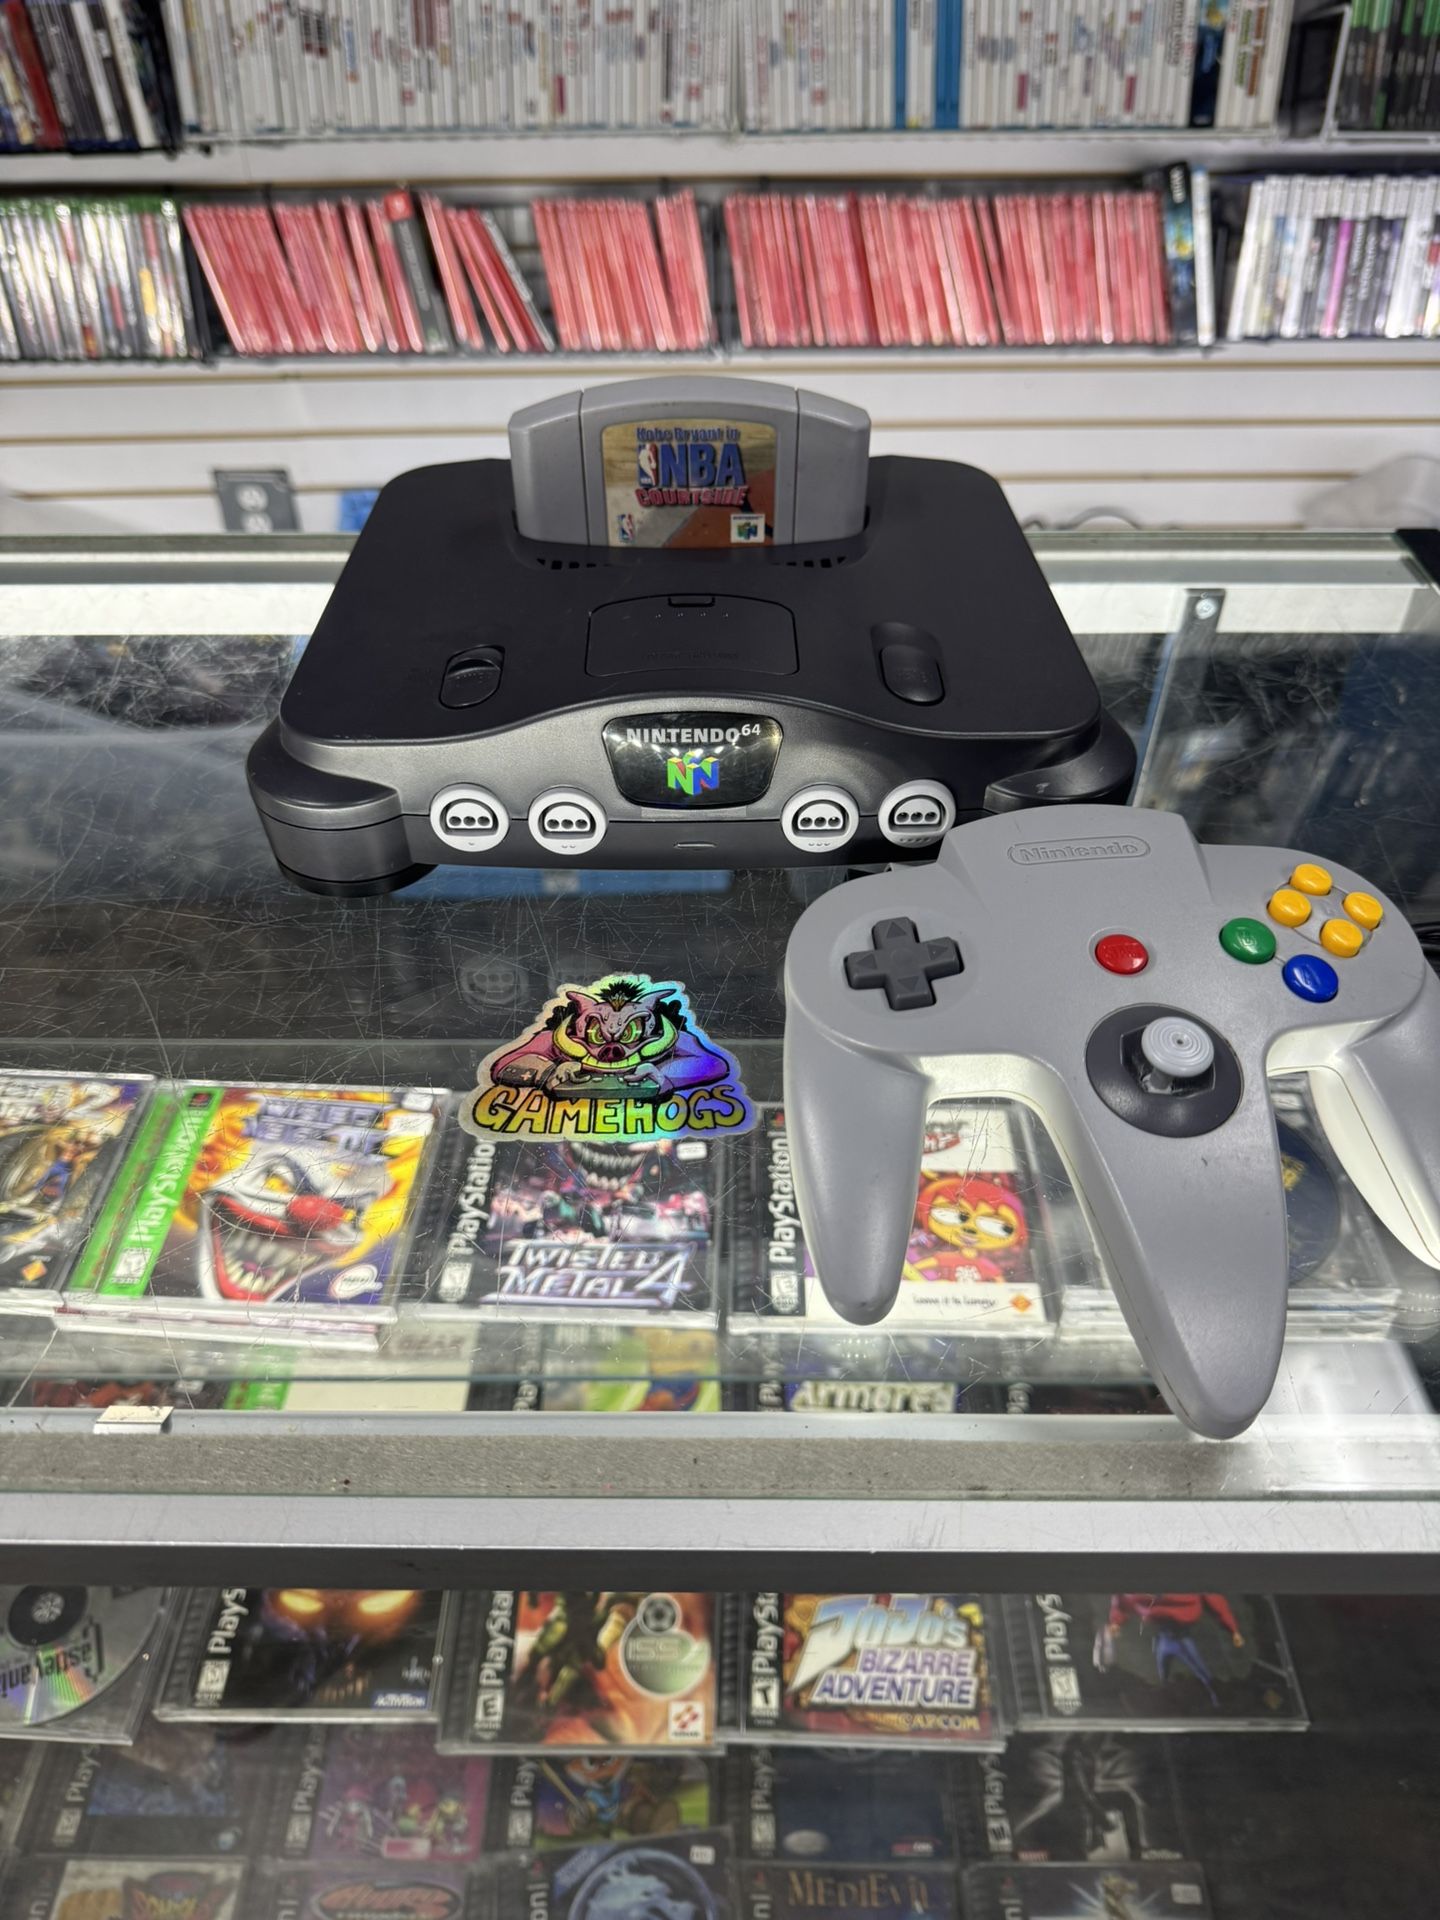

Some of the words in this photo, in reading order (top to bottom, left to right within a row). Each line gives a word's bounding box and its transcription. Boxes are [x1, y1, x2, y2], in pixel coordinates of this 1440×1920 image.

[660, 443, 746, 488] NBA
[1019, 842, 1139, 862] Nintendo
[472, 1084, 747, 1135] GAMEHOGS
[447, 1139, 496, 1256] PlayStatio
[480, 1590, 514, 1688] PlaySta
[860, 1649, 972, 1677] BIZARRE
[815, 1673, 974, 1705] ADVENTURE
